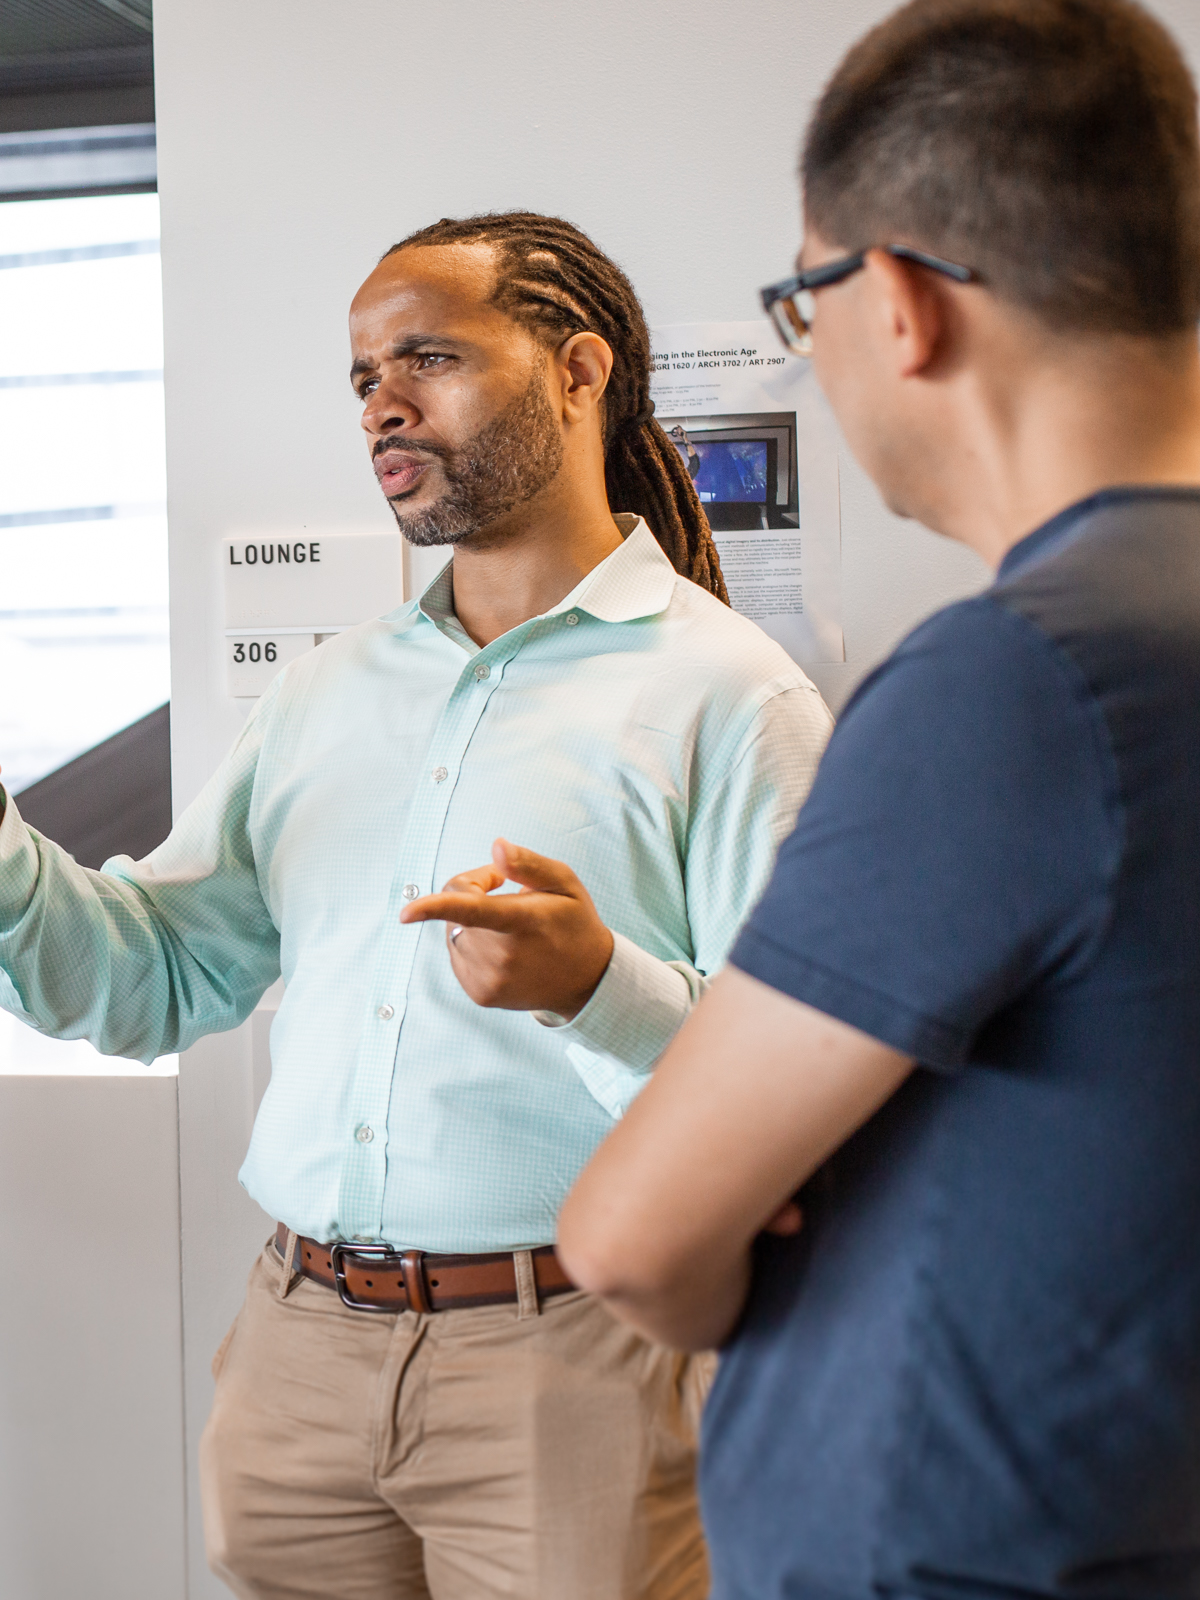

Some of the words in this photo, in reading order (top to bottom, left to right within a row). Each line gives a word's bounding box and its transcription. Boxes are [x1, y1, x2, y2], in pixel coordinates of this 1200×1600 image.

[671, 351, 679, 359] in
[681, 350, 694, 358] the
[697, 348, 737, 357] Electronic
[740, 348, 757, 357] Age
[672, 362, 690, 370] 1620
[698, 360, 719, 368] ARCH
[722, 359, 741, 367] 3702
[749, 358, 764, 366] ART
[767, 357, 786, 365] 2907
[230, 542, 320, 565] LOUNGE
[233, 642, 277, 663] 306
